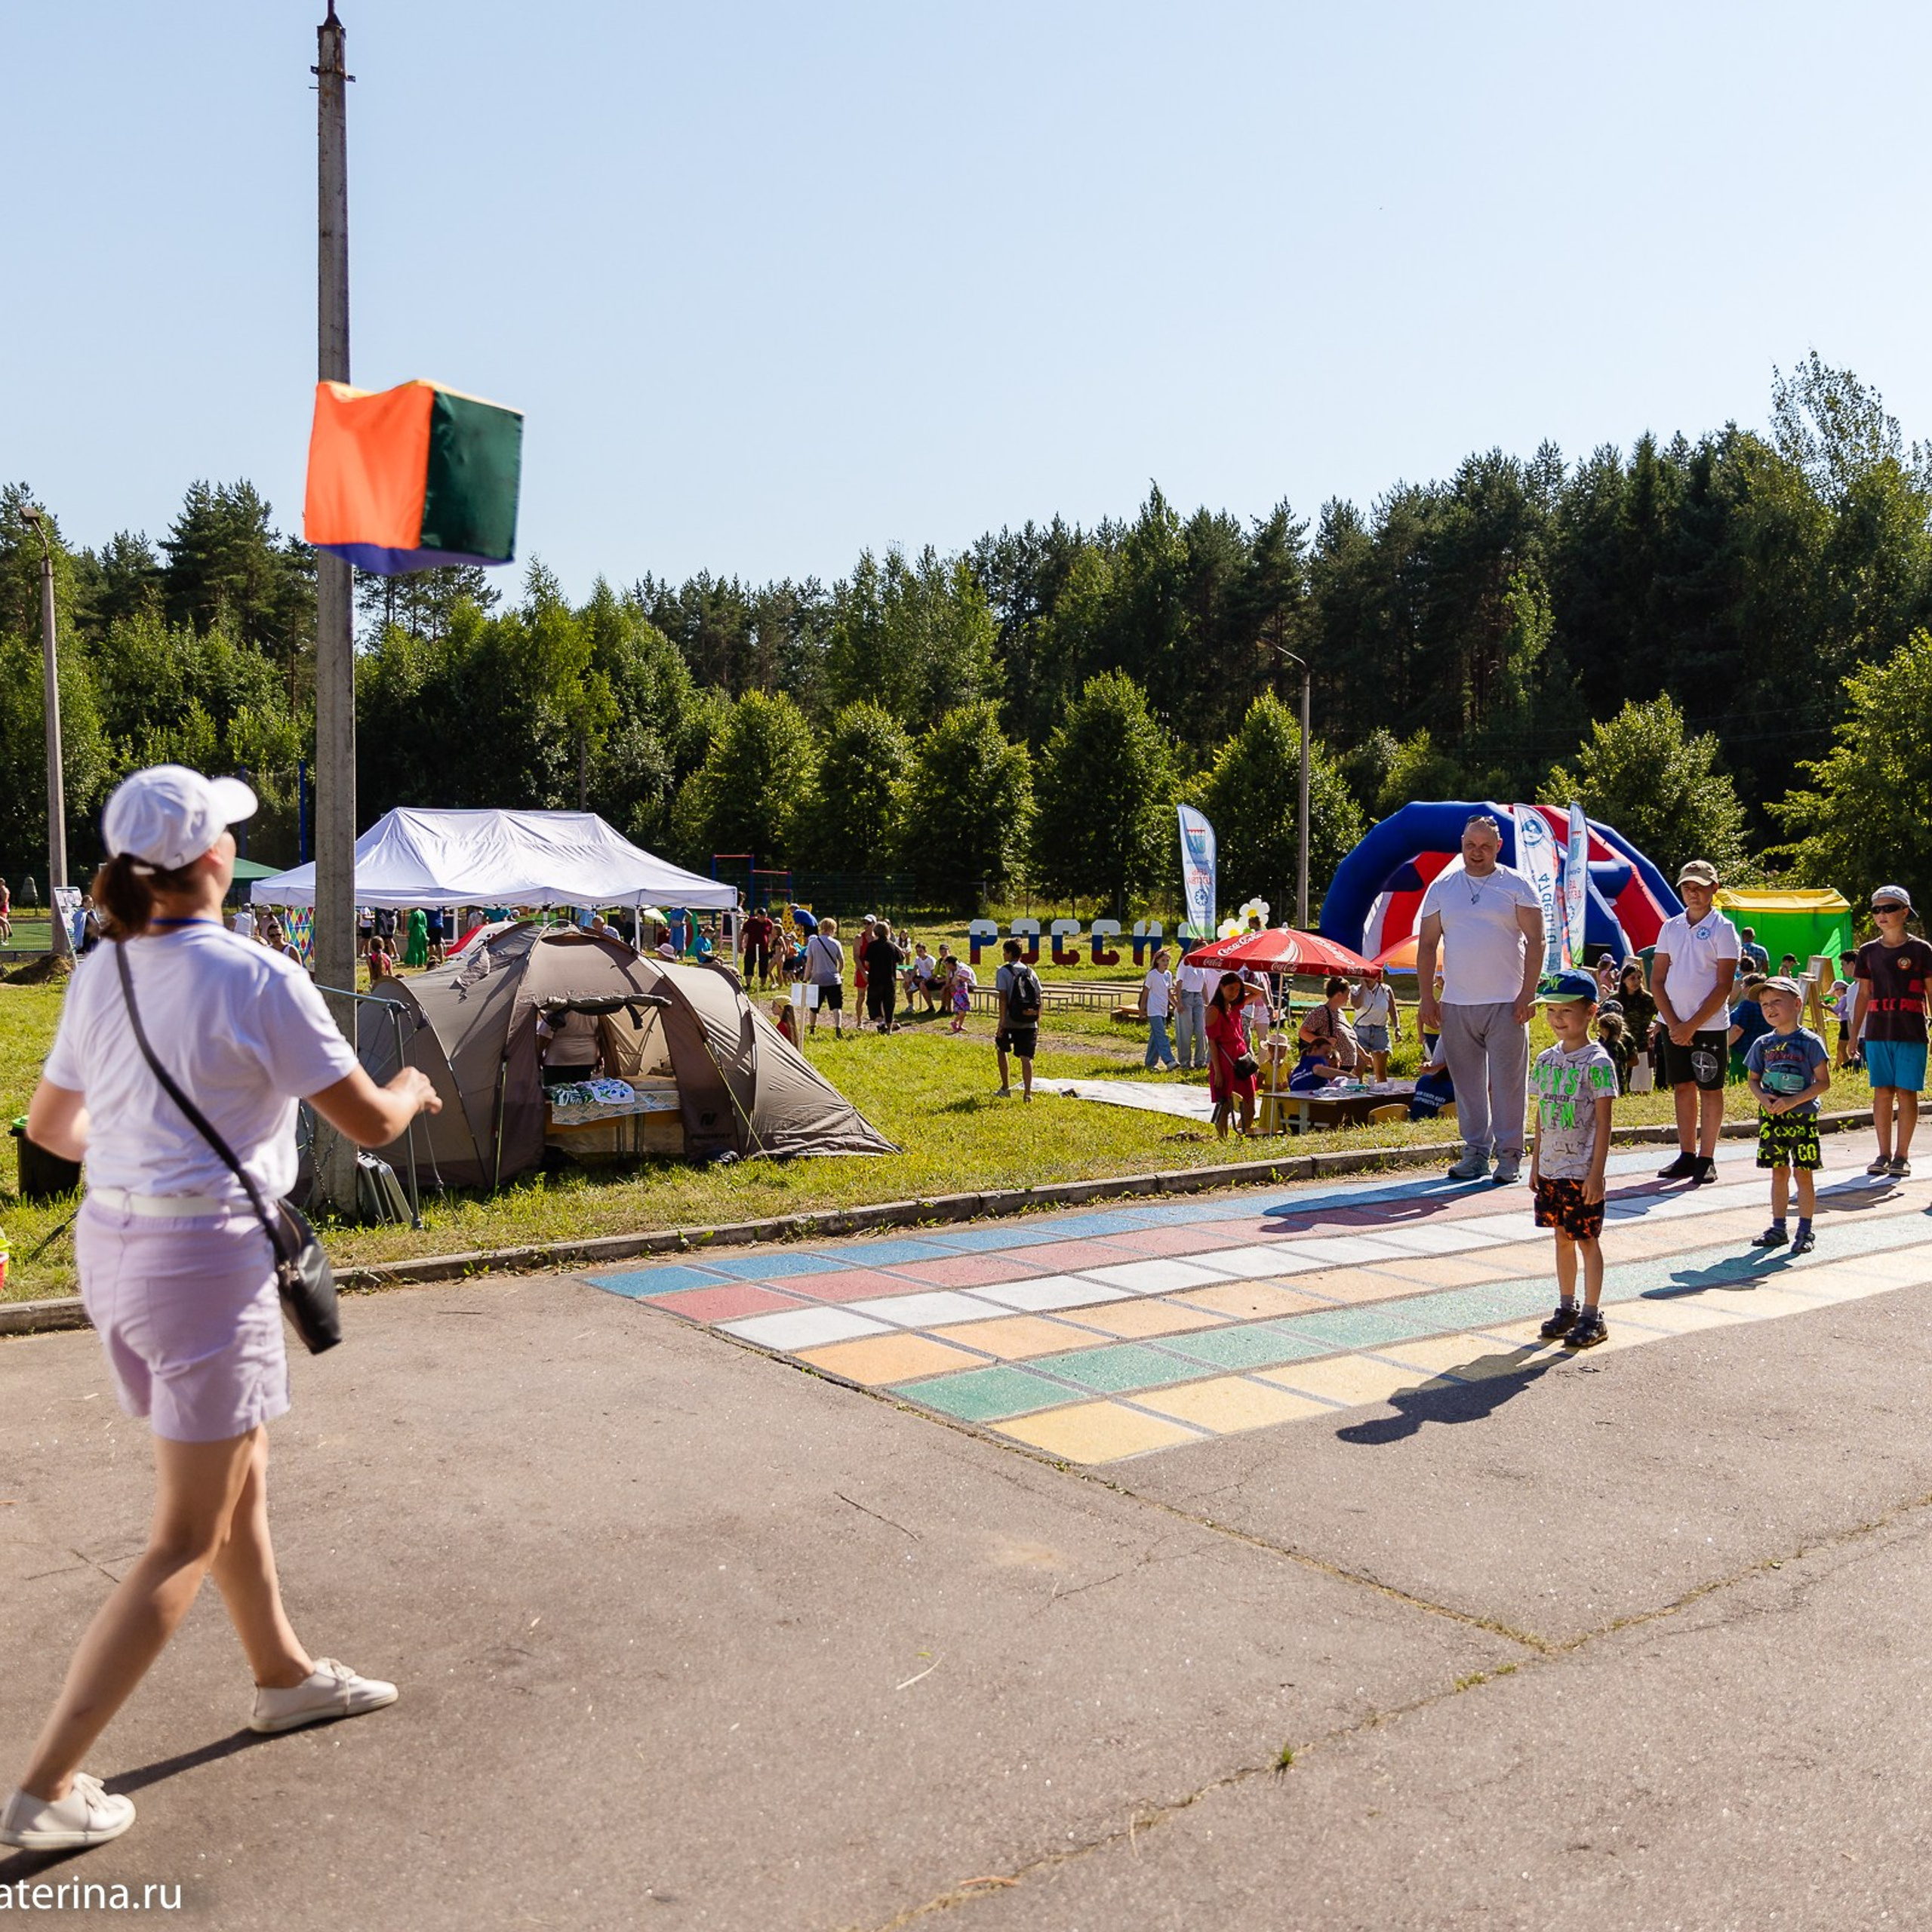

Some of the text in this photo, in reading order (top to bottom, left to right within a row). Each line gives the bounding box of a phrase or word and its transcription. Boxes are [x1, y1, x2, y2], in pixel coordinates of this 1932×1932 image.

[1217, 932, 1264, 956] Coca-Cola
[1271, 961, 1298, 972] Coca-Cola
[1547, 975, 1564, 990] NY
